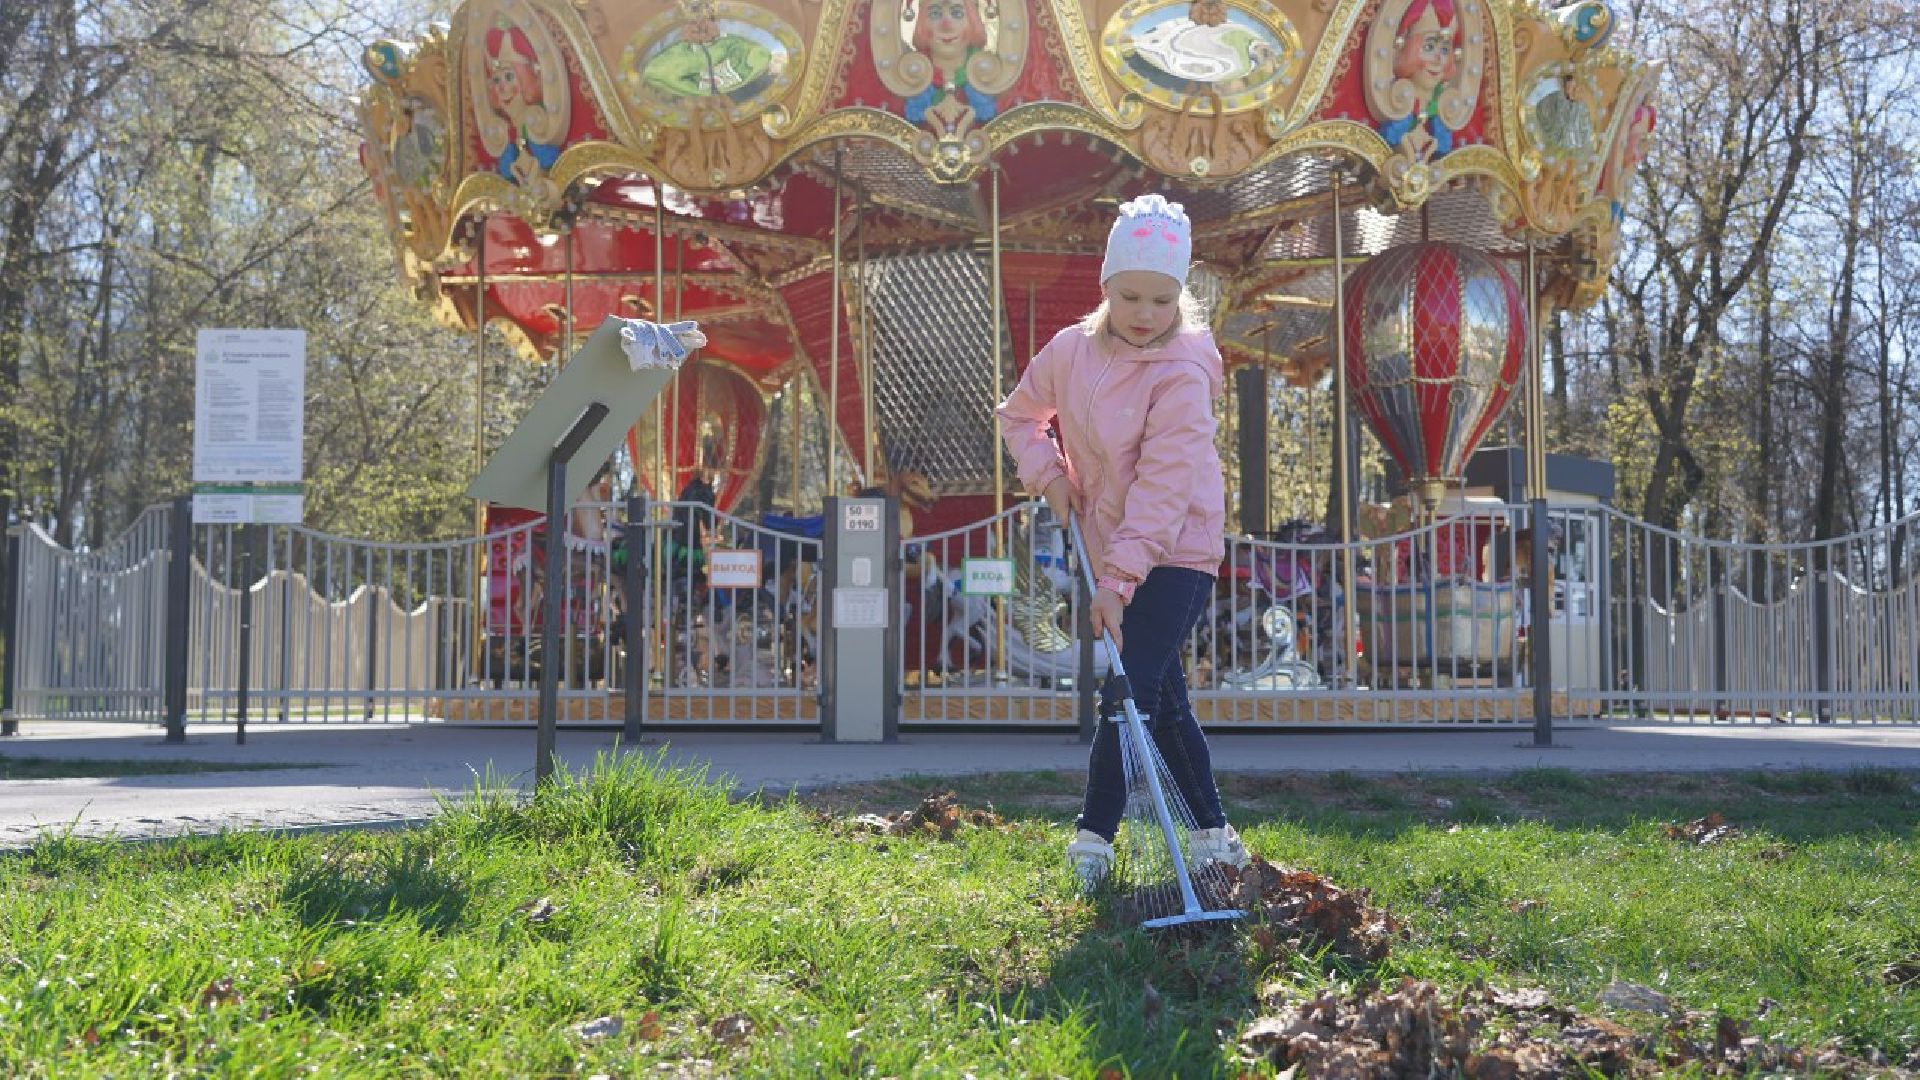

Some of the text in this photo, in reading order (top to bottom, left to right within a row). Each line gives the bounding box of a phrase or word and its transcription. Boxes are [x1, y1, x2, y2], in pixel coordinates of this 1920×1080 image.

[849, 506, 862, 515] 50
[713, 563, 755, 574] ВЫХОД
[972, 571, 1004, 582] ВХОД
